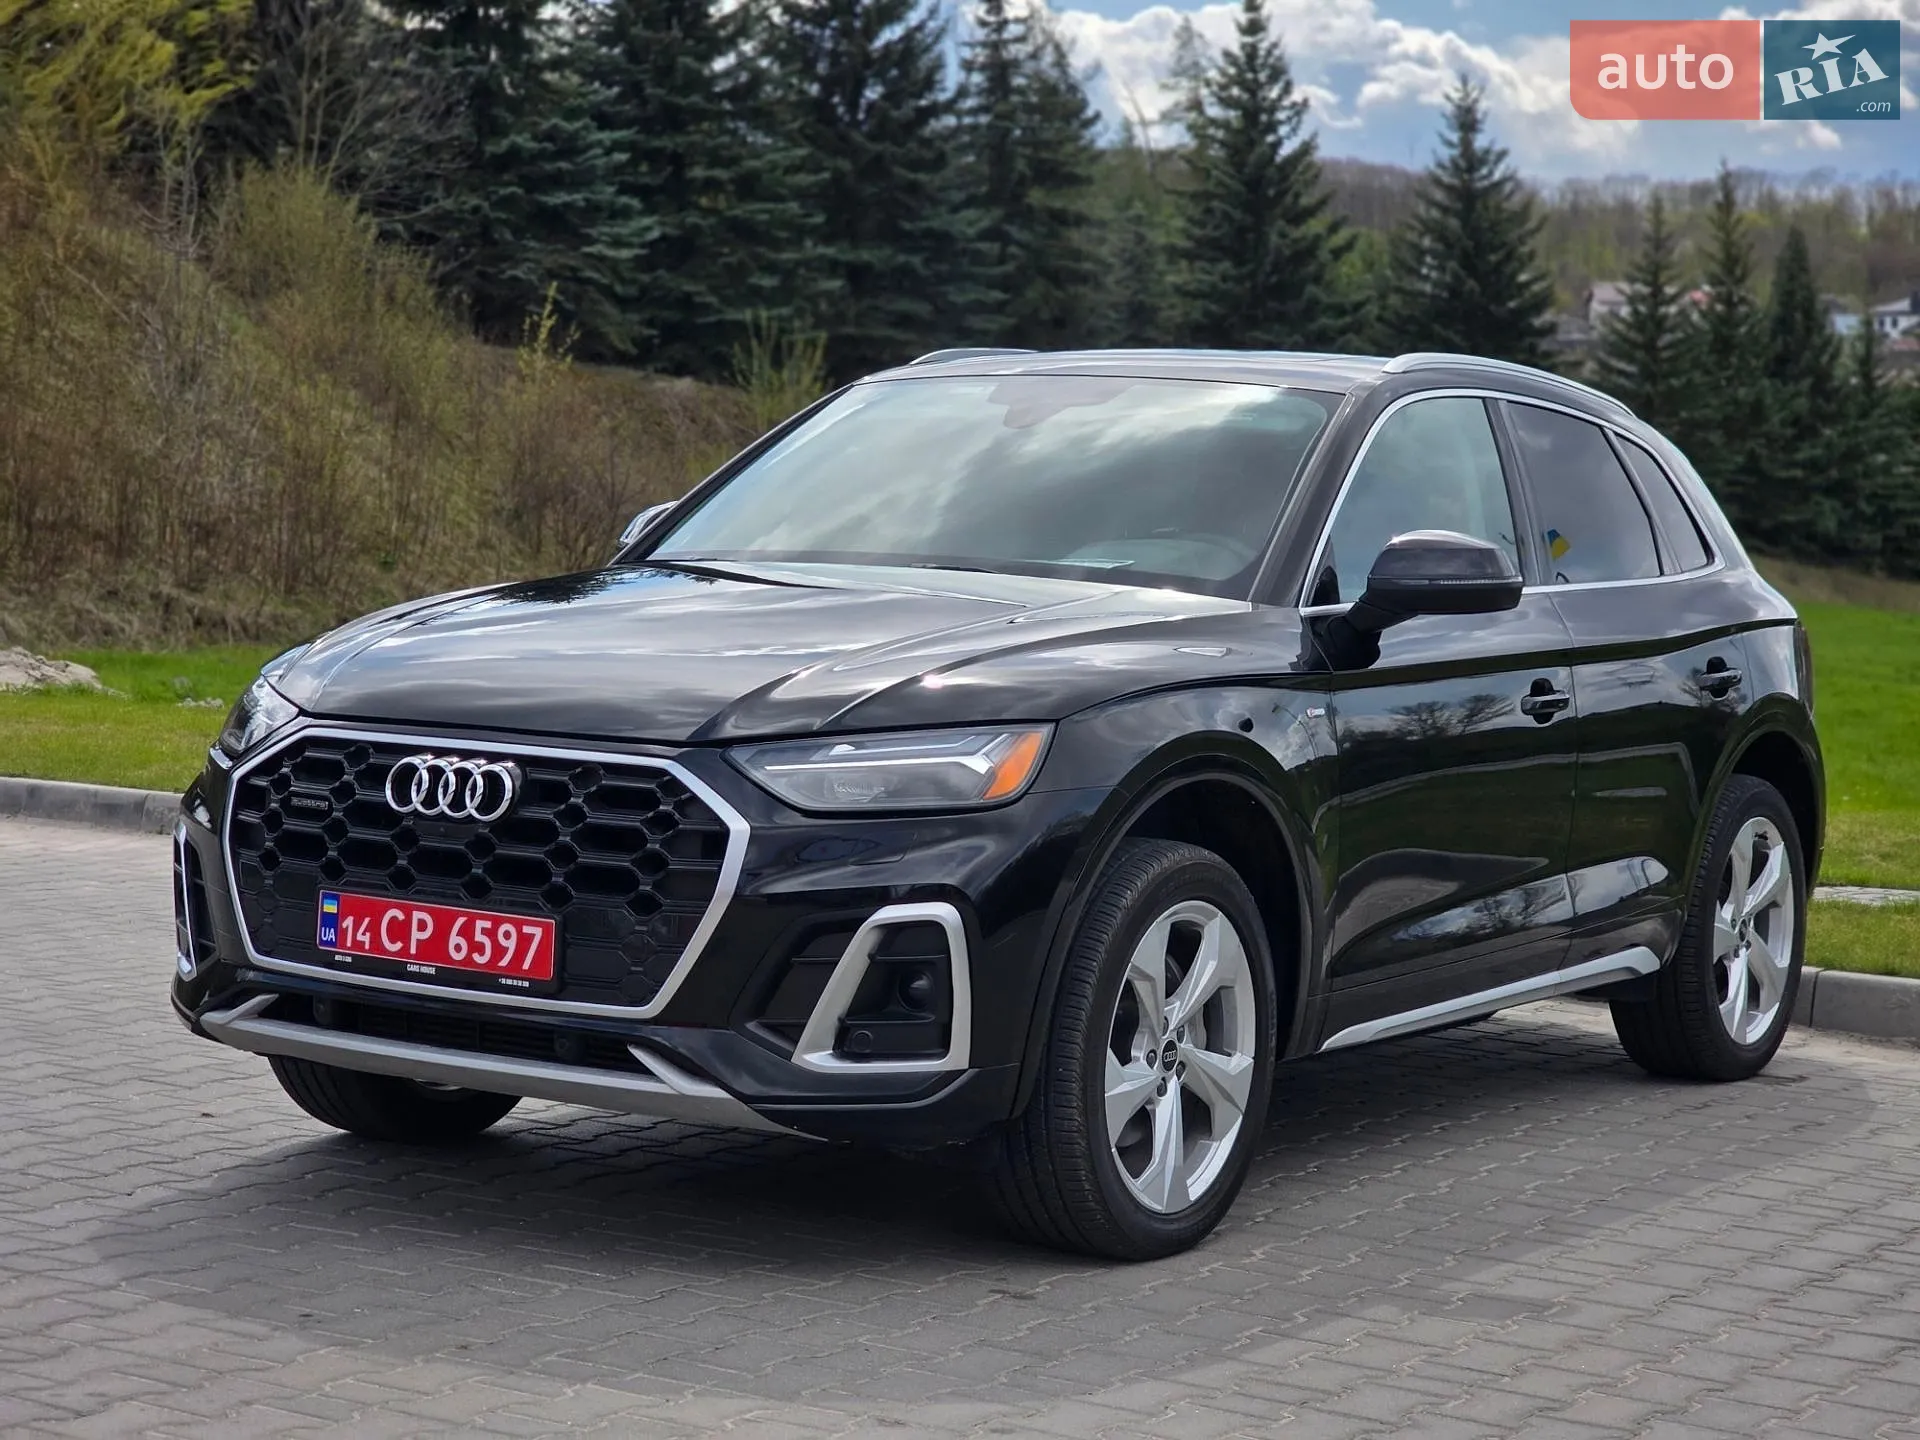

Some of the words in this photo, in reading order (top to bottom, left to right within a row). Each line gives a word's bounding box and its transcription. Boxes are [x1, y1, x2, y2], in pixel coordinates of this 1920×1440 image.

[321, 927, 336, 943] UA
[342, 915, 371, 950] 14
[380, 908, 434, 955] CP
[448, 916, 543, 970] 6597
